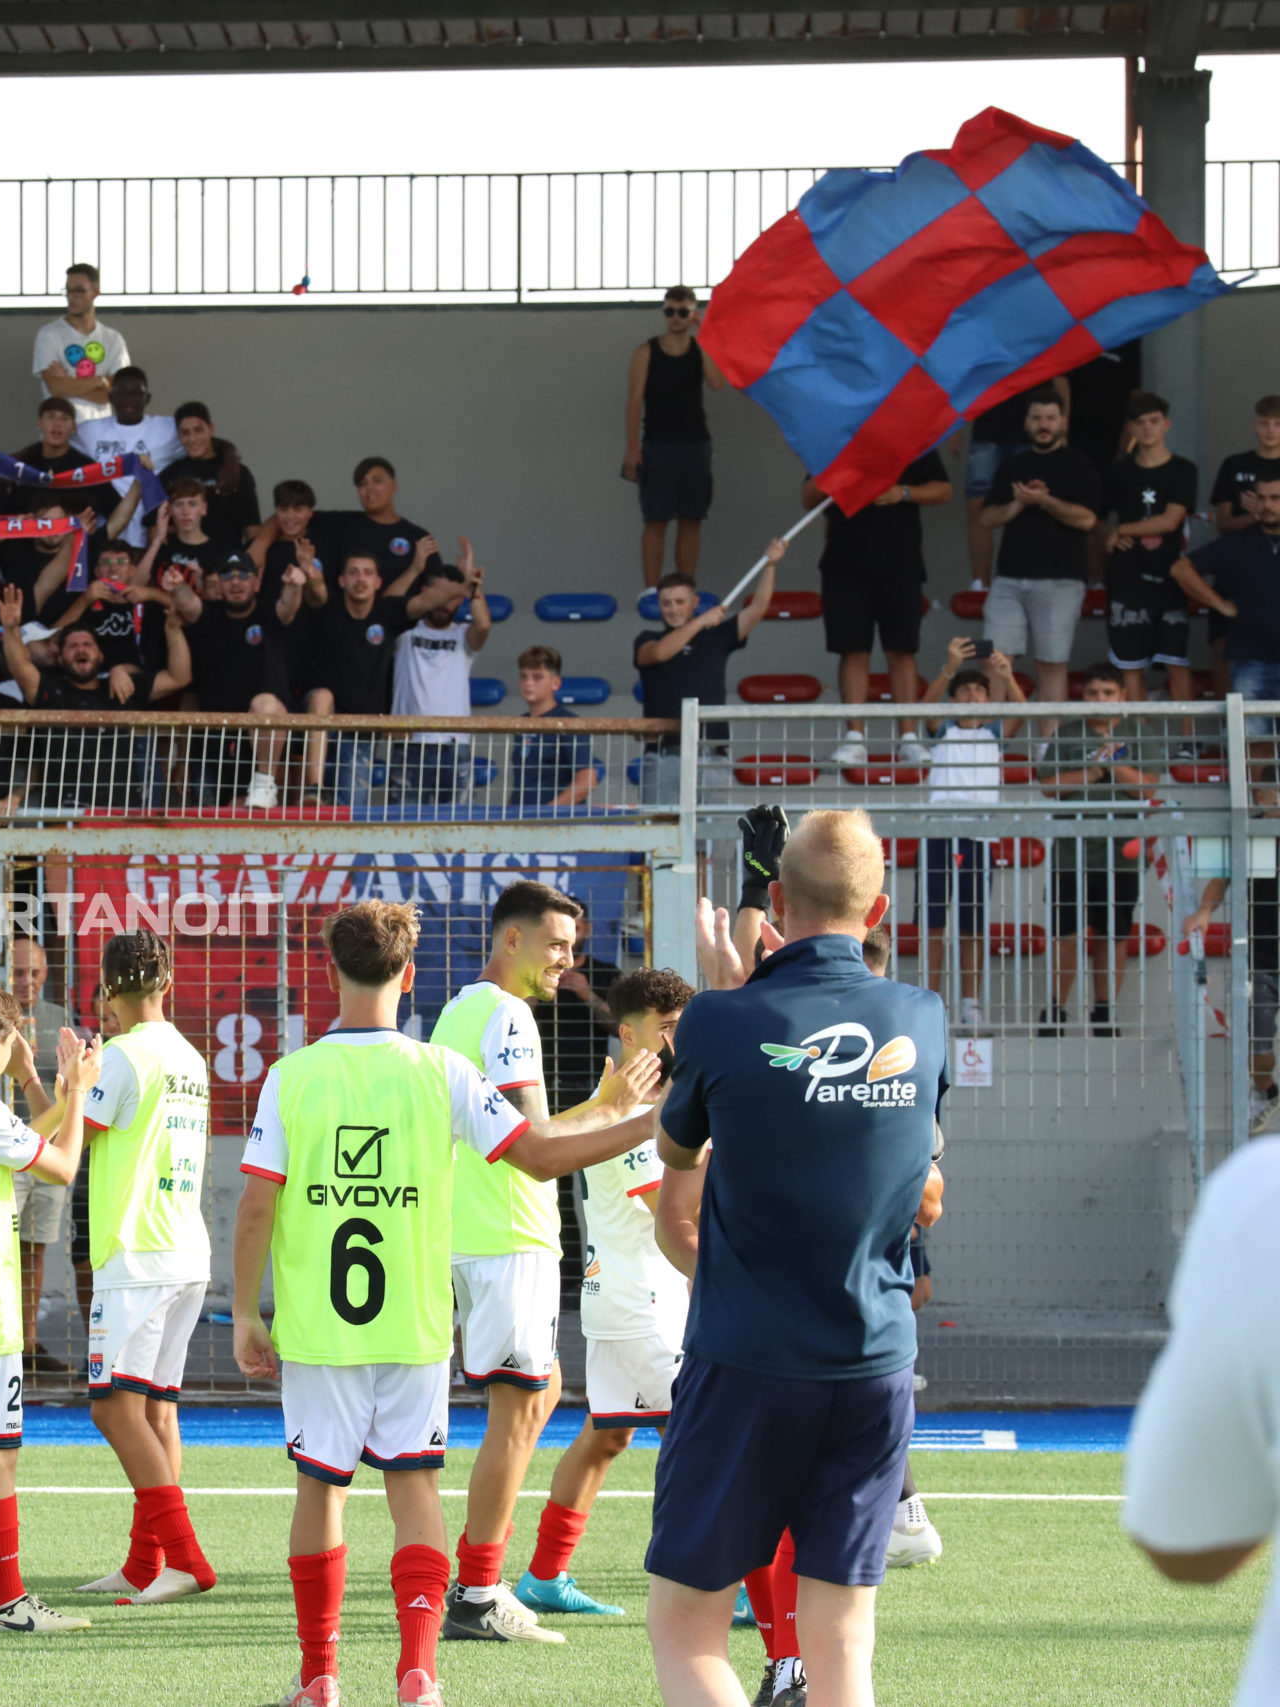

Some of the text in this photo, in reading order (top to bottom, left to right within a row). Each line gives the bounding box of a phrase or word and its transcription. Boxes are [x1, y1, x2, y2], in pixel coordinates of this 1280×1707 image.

[126, 853, 578, 904] GRAZZANISE
[800, 1022, 917, 1102] Parente
[863, 1100, 897, 1108] Service
[307, 1184, 418, 1208] GIVOVA
[330, 1217, 386, 1326] 6
